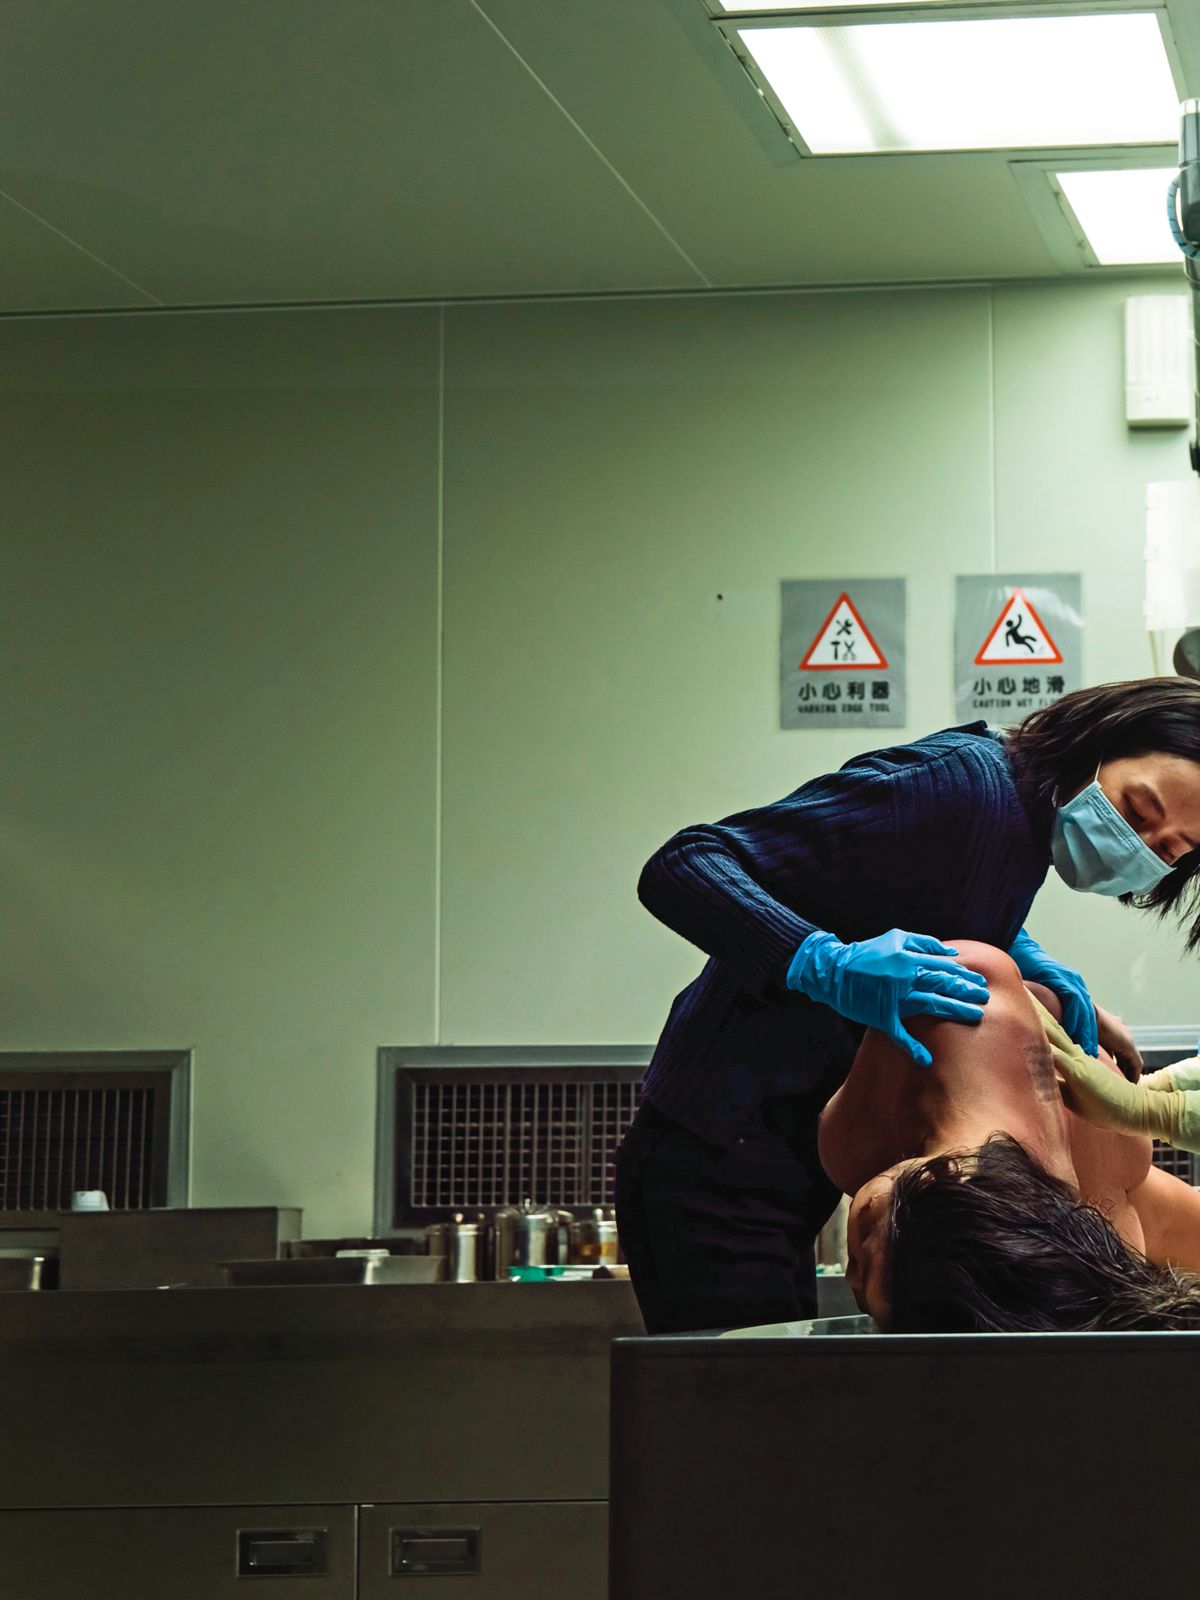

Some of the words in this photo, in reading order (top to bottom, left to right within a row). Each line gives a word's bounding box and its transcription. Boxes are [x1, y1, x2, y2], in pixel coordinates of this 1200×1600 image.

[799, 681, 889, 701] 小心利器
[974, 676, 1064, 695] 小心地滑
[799, 703, 837, 713] WARNING
[973, 699, 1011, 708] CAUTION
[1017, 698, 1032, 708] WET
